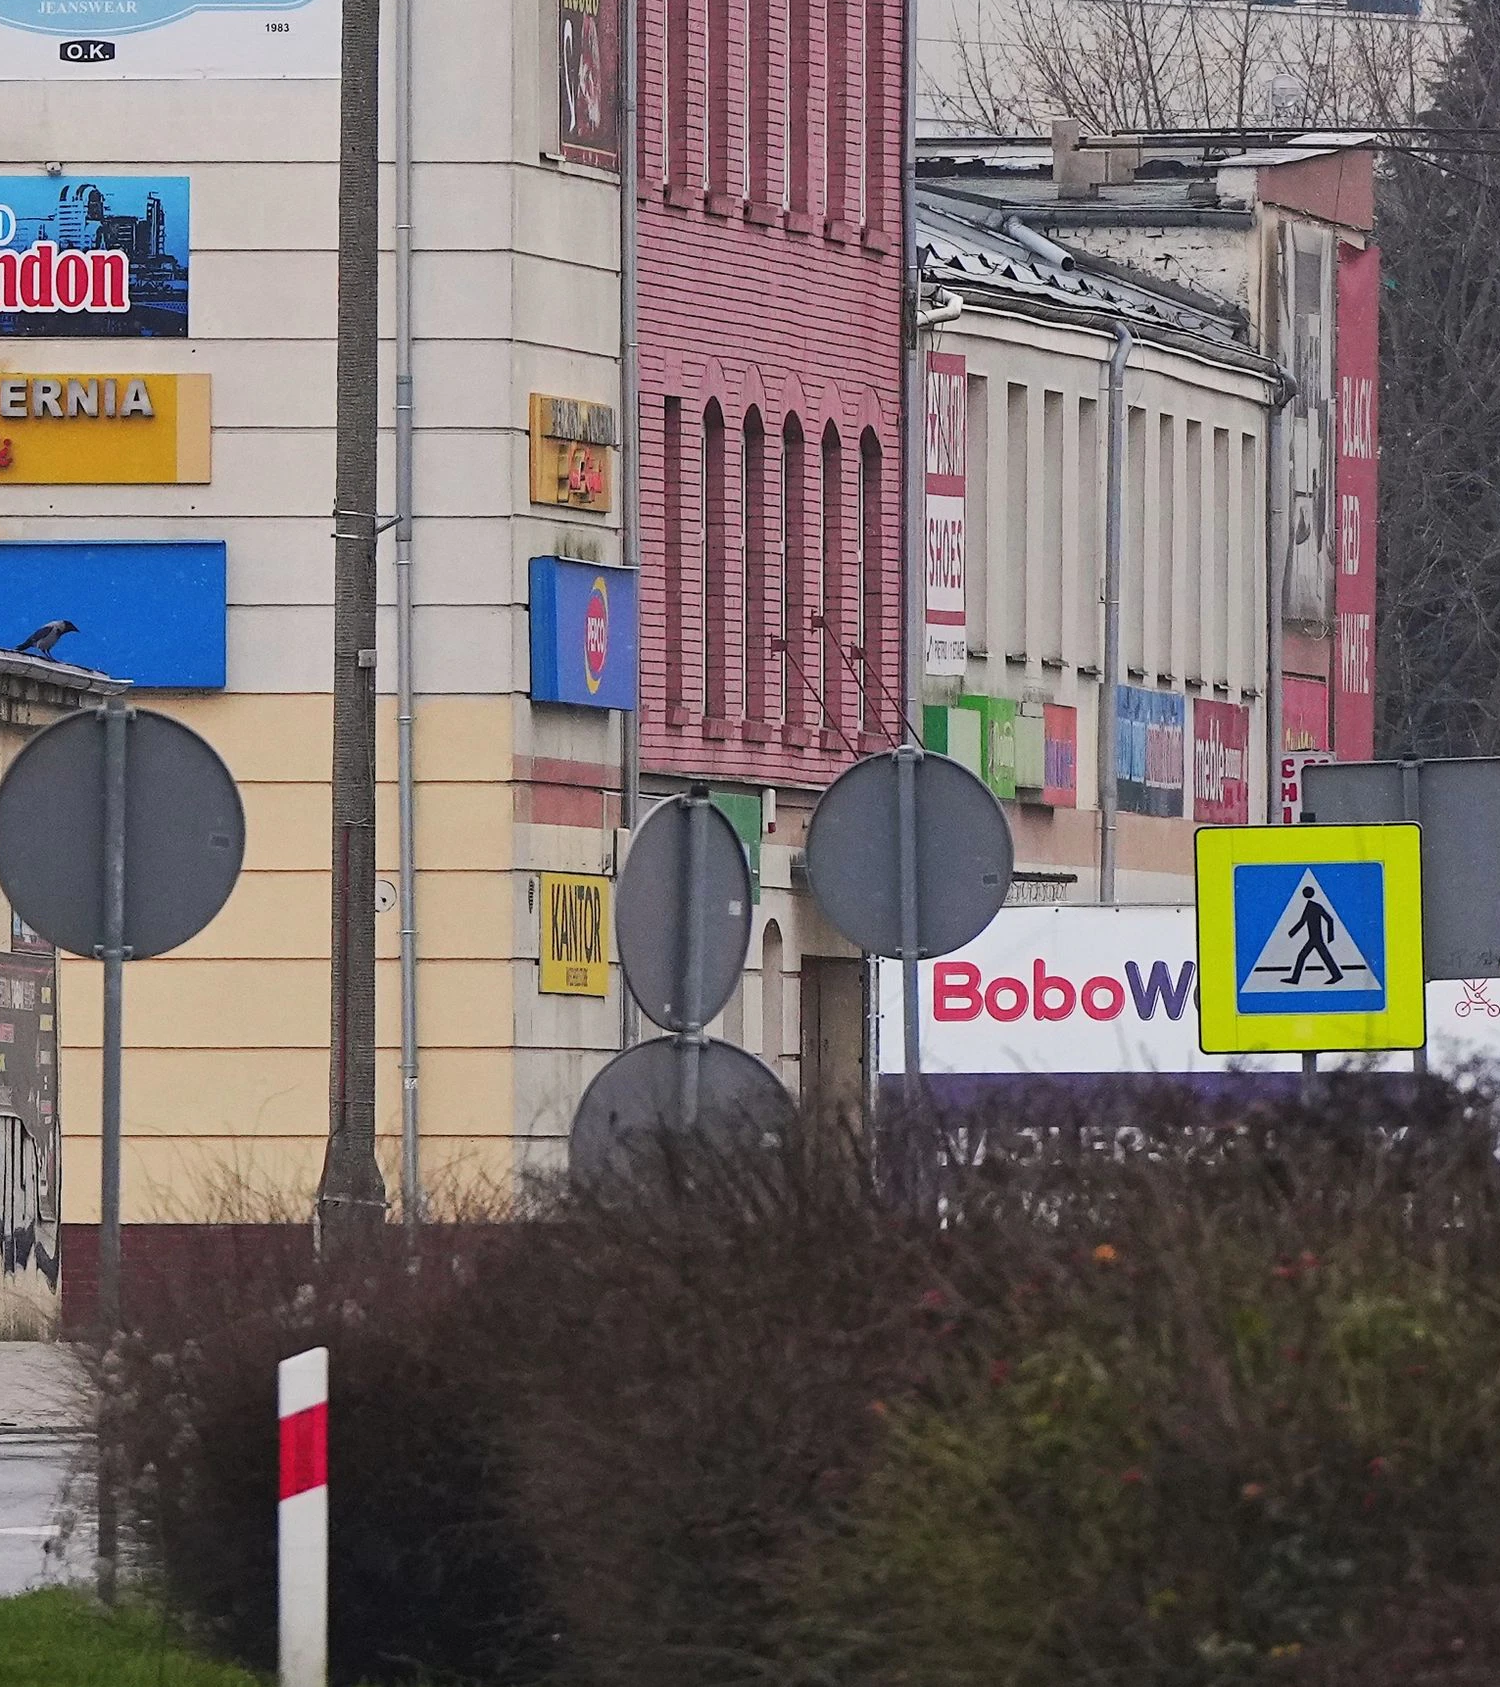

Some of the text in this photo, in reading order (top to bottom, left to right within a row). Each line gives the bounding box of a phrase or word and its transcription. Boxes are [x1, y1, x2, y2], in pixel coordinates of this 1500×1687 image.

[37, 0, 138, 14] JEANSWEAR
[264, 21, 291, 34] 1983
[65, 42, 111, 61] O.K.
[1342, 376, 1372, 459] BLACK
[929, 518, 963, 589] SHOES
[1342, 495, 1360, 575] RED
[1341, 612, 1370, 694] WHITE
[551, 883, 602, 964] KANTOR
[933, 958, 1199, 1022] BoboW
